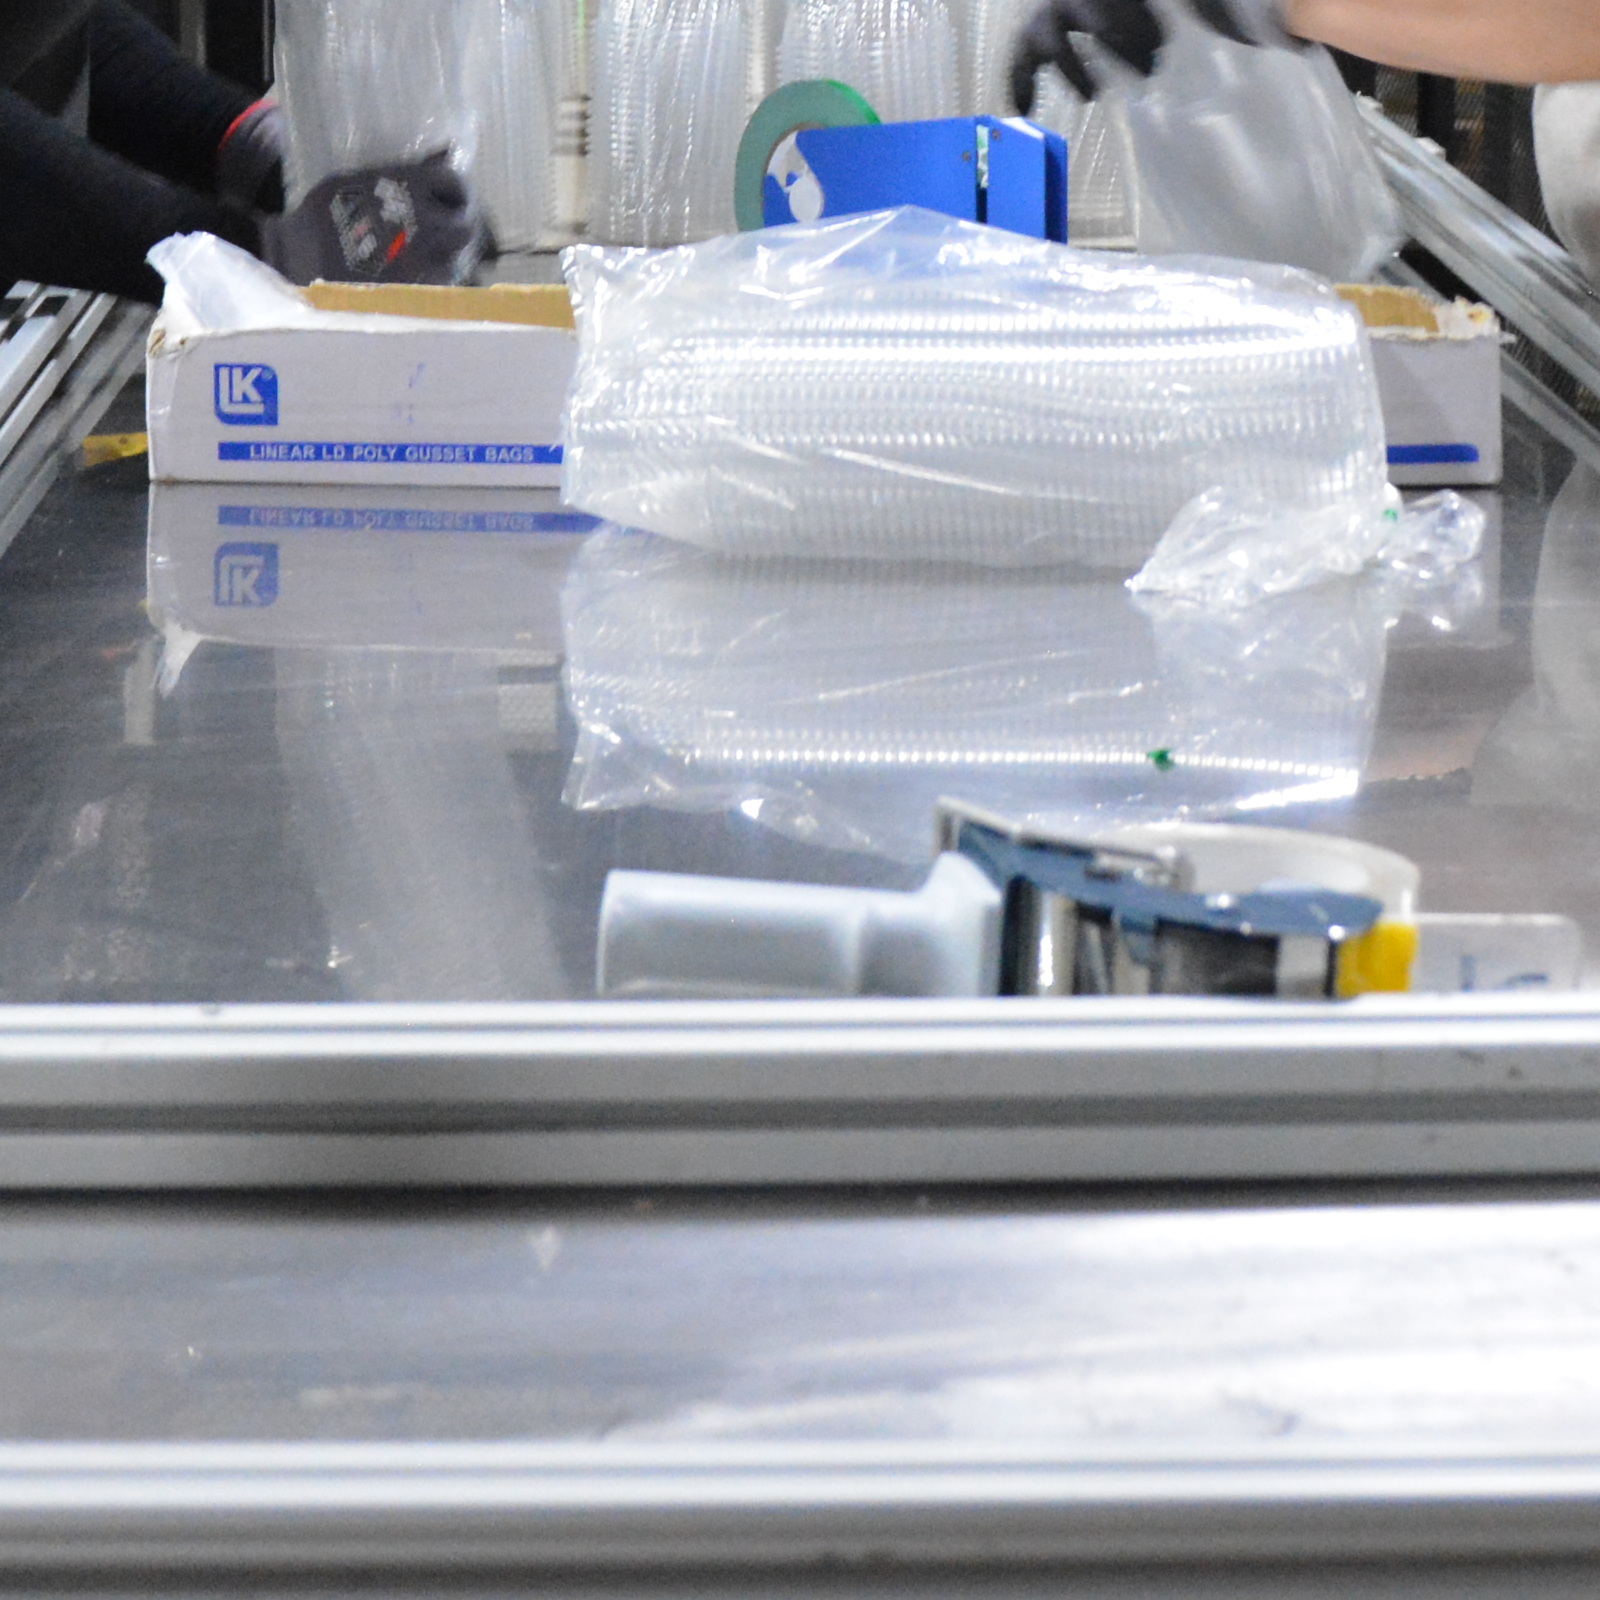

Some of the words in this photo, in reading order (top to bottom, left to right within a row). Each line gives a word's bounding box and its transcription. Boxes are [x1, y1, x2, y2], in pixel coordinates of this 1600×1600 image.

[217, 364, 266, 416] LK
[250, 444, 316, 460] LINEAR
[322, 444, 345, 461] LD
[352, 445, 398, 462] POLY
[405, 446, 476, 463] GUSSET
[485, 446, 534, 463] BAGS
